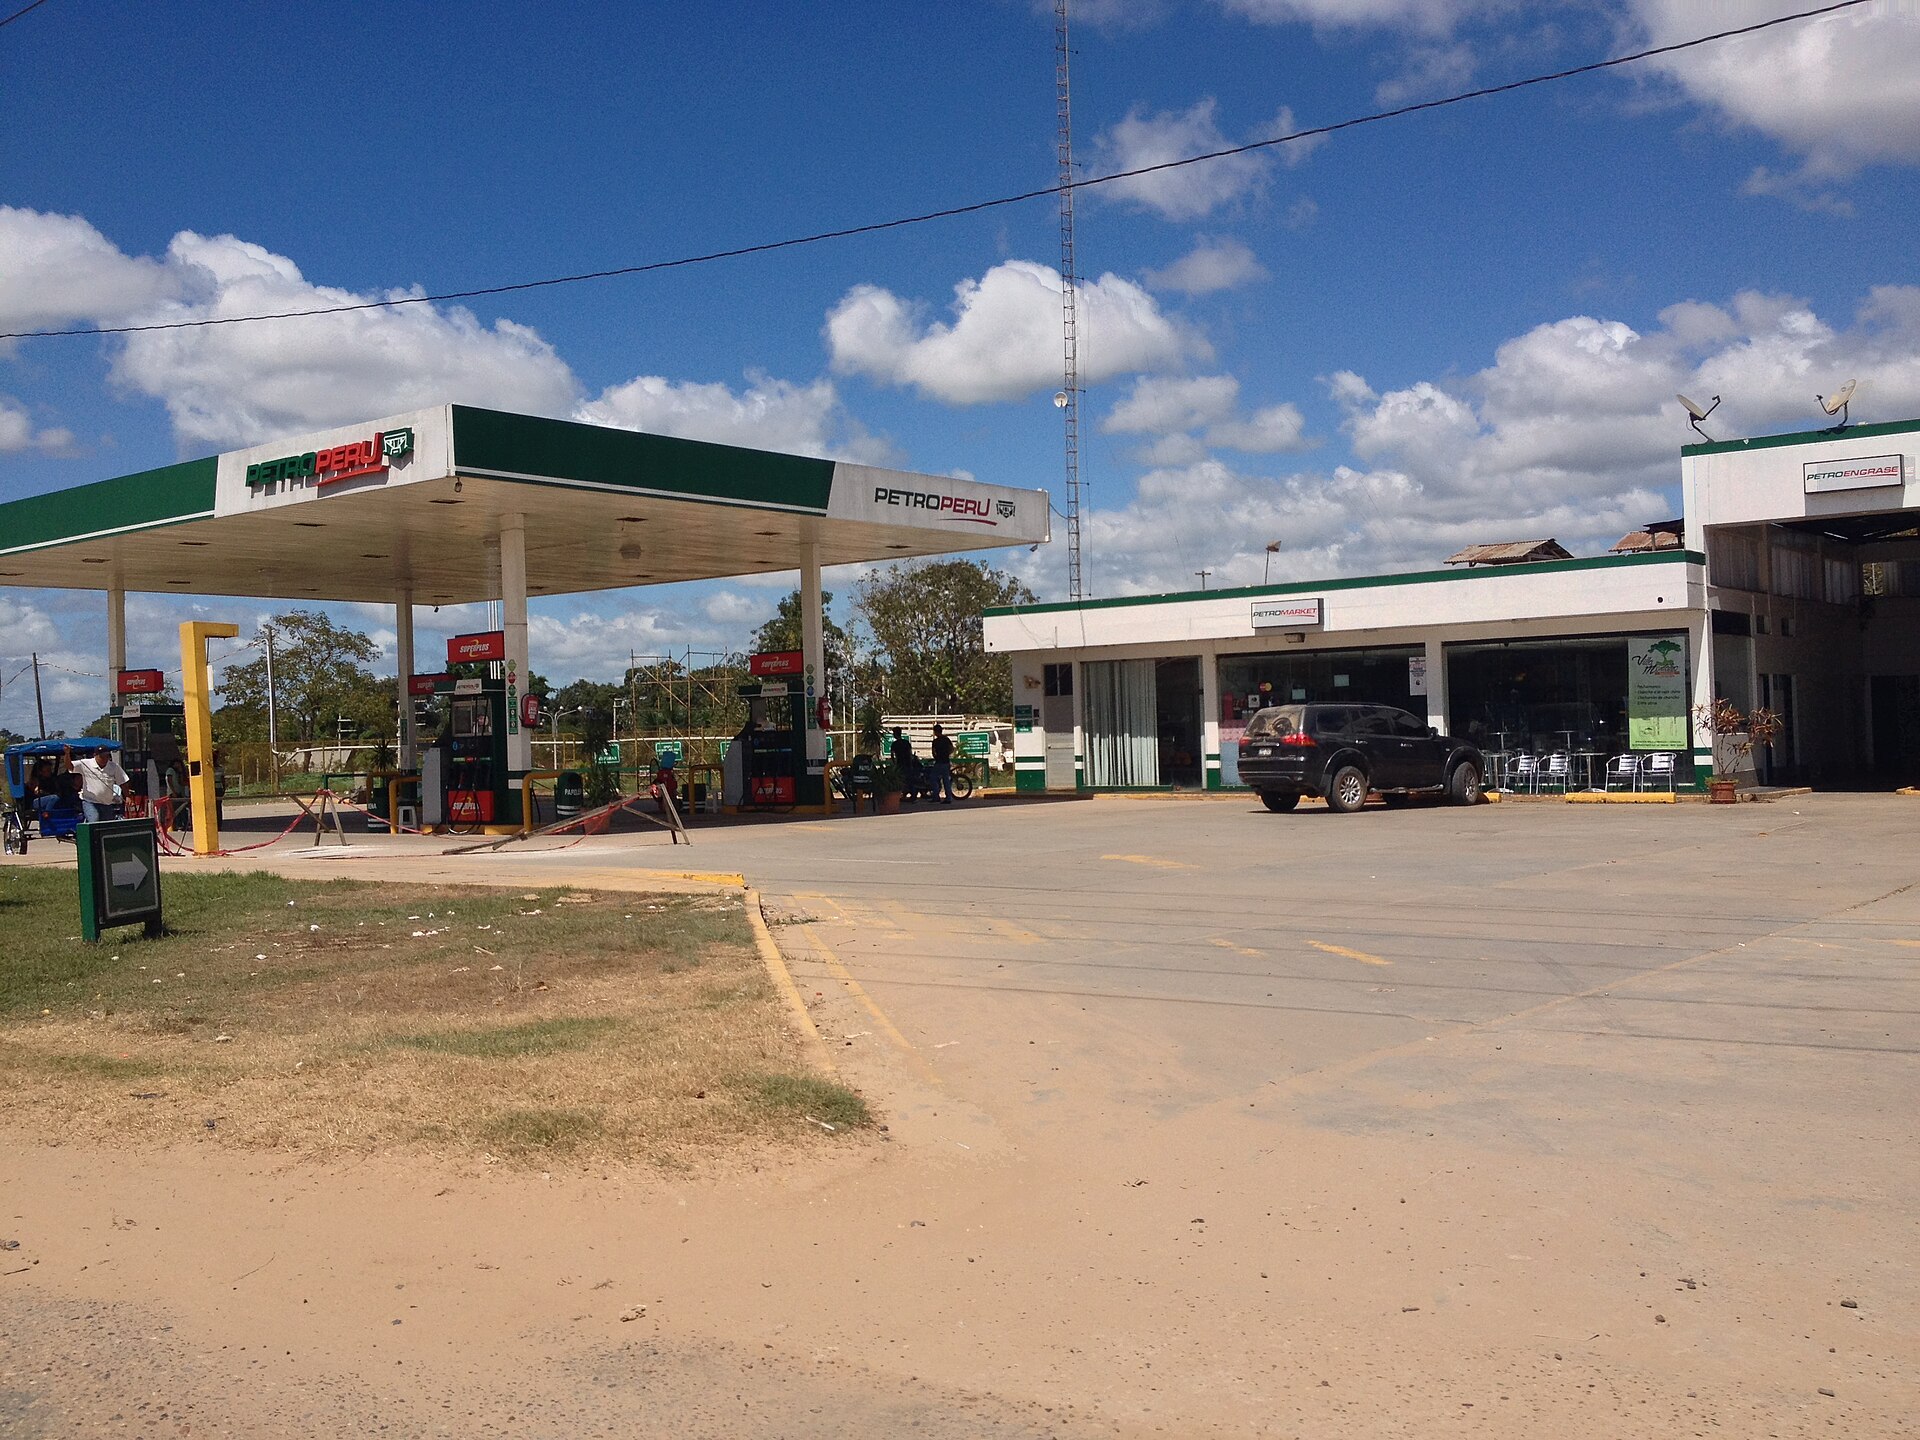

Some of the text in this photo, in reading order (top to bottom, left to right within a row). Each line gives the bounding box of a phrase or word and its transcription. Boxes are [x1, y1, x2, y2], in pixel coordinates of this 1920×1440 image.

[245, 432, 384, 487] PETROPERU
[1806, 465, 1899, 480] PETROENGRASE
[874, 487, 991, 517] PETROPERU
[1252, 607, 1317, 618] PETROMARKET
[459, 643, 490, 653] SUPERPLUS
